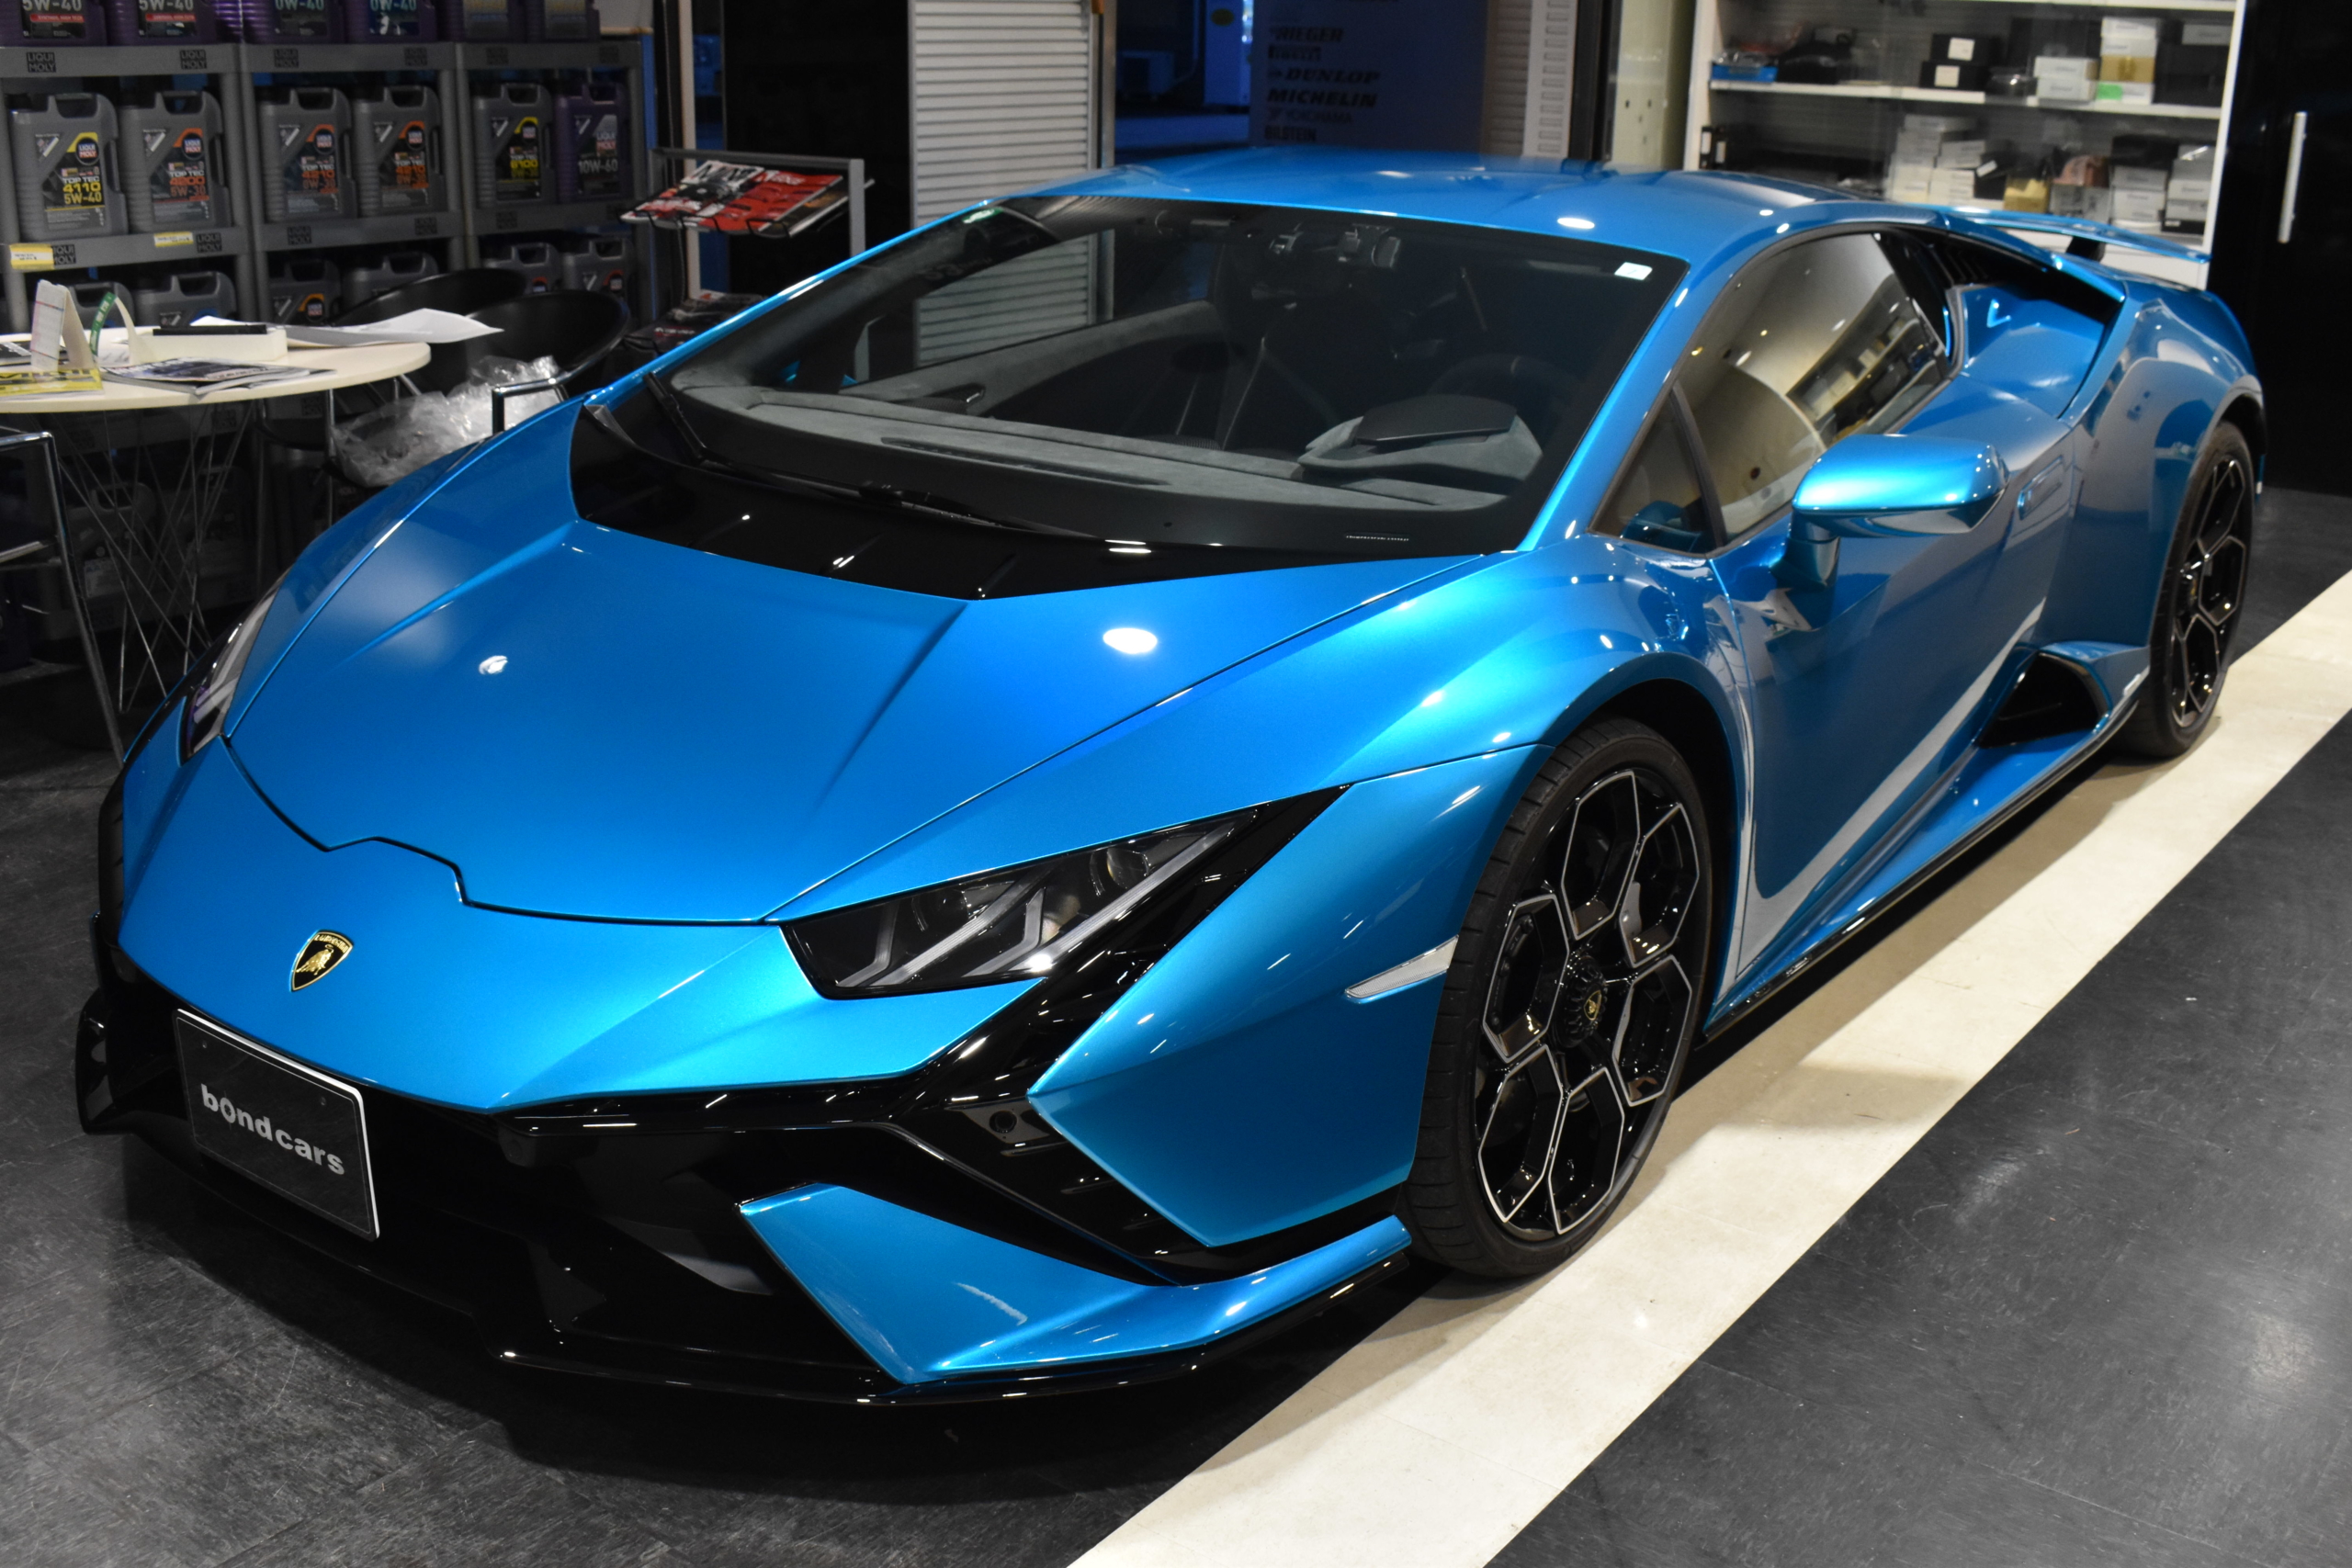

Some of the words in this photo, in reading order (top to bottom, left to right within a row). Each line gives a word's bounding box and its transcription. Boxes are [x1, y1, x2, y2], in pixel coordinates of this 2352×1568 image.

[28, 52, 54, 62] LIQUI
[182, 50, 205, 59] LIQUI
[28, 62, 55, 72] MOLY
[1285, 68, 1380, 84] DUNLOP
[1267, 88, 1376, 107] MICHELIN
[579, 159, 618, 174] 10W-60
[62, 182, 101, 193] 4110
[63, 192, 102, 205] 5W-40
[53, 245, 74, 254] IQUI
